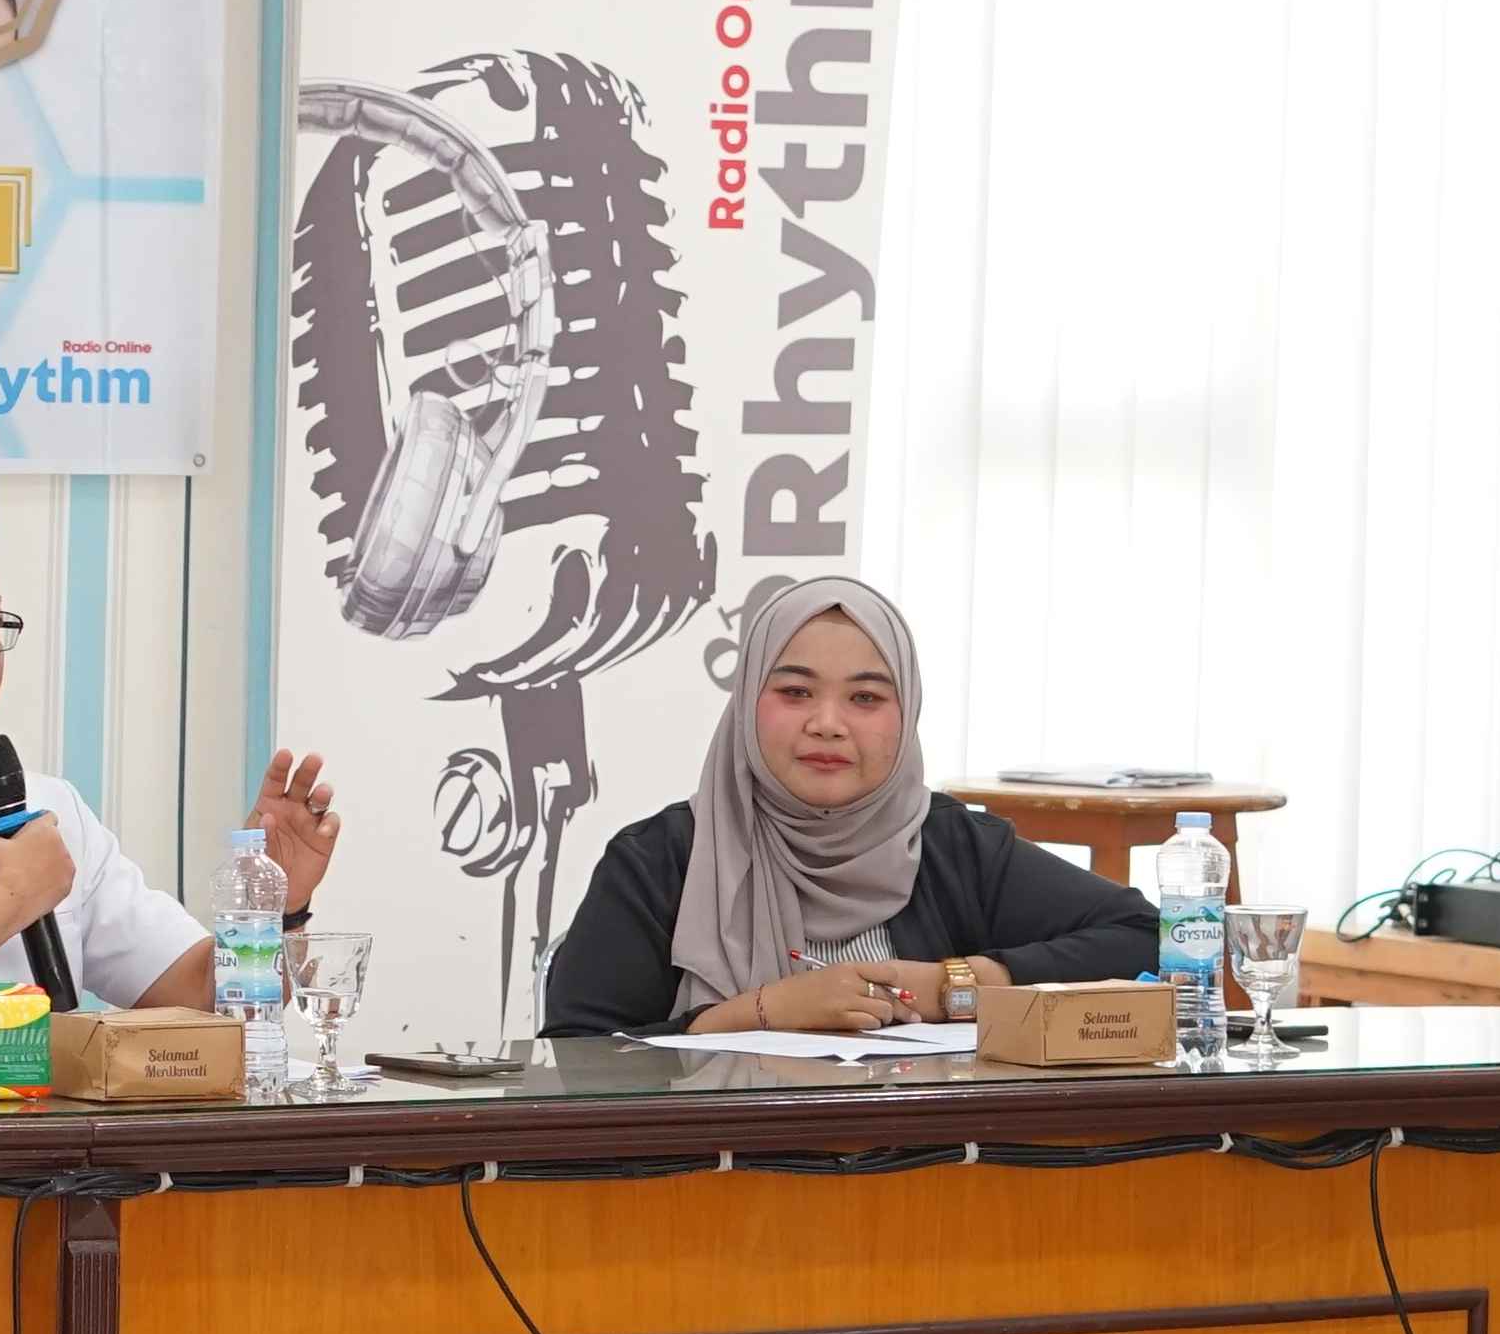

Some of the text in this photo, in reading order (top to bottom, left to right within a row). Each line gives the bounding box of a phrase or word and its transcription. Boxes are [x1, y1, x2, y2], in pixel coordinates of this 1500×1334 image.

[708, 64, 751, 230] Radio
[62, 341, 153, 355] Radio Online
[1083, 1011, 1131, 1025] Selamat
[1078, 1026, 1138, 1041] Menikmati
[148, 1048, 201, 1063] Selamat
[144, 1064, 208, 1078] Menikmati
